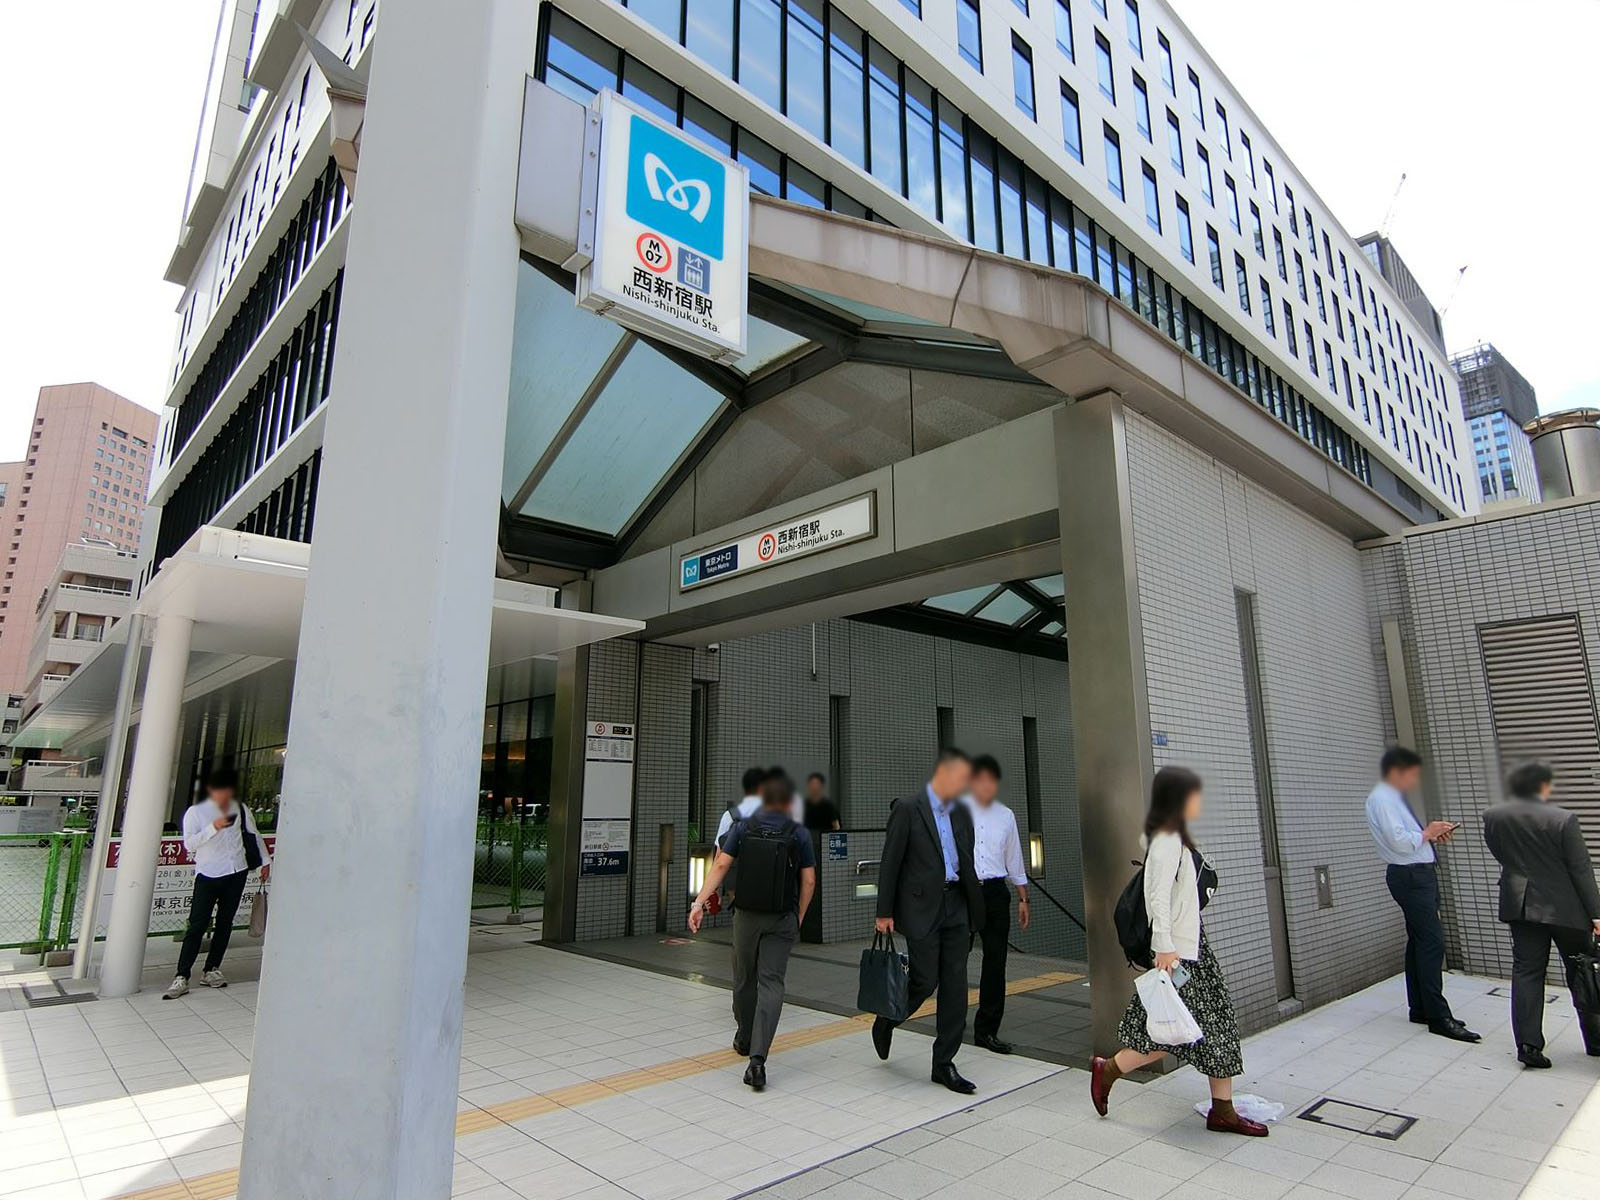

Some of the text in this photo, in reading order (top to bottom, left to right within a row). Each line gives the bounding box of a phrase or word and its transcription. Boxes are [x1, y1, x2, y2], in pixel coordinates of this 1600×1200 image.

[649, 239, 660, 252] M
[645, 250, 663, 264] 07
[633, 266, 713, 318] 西新宿駅
[622, 284, 721, 334] Nishi-shinjuku Sta.
[777, 519, 820, 545] 西新宿駅
[777, 528, 845, 555] Nishi-shinjuku Sta.
[705, 551, 732, 567] 東京メトロ
[762, 546, 771, 555] 07
